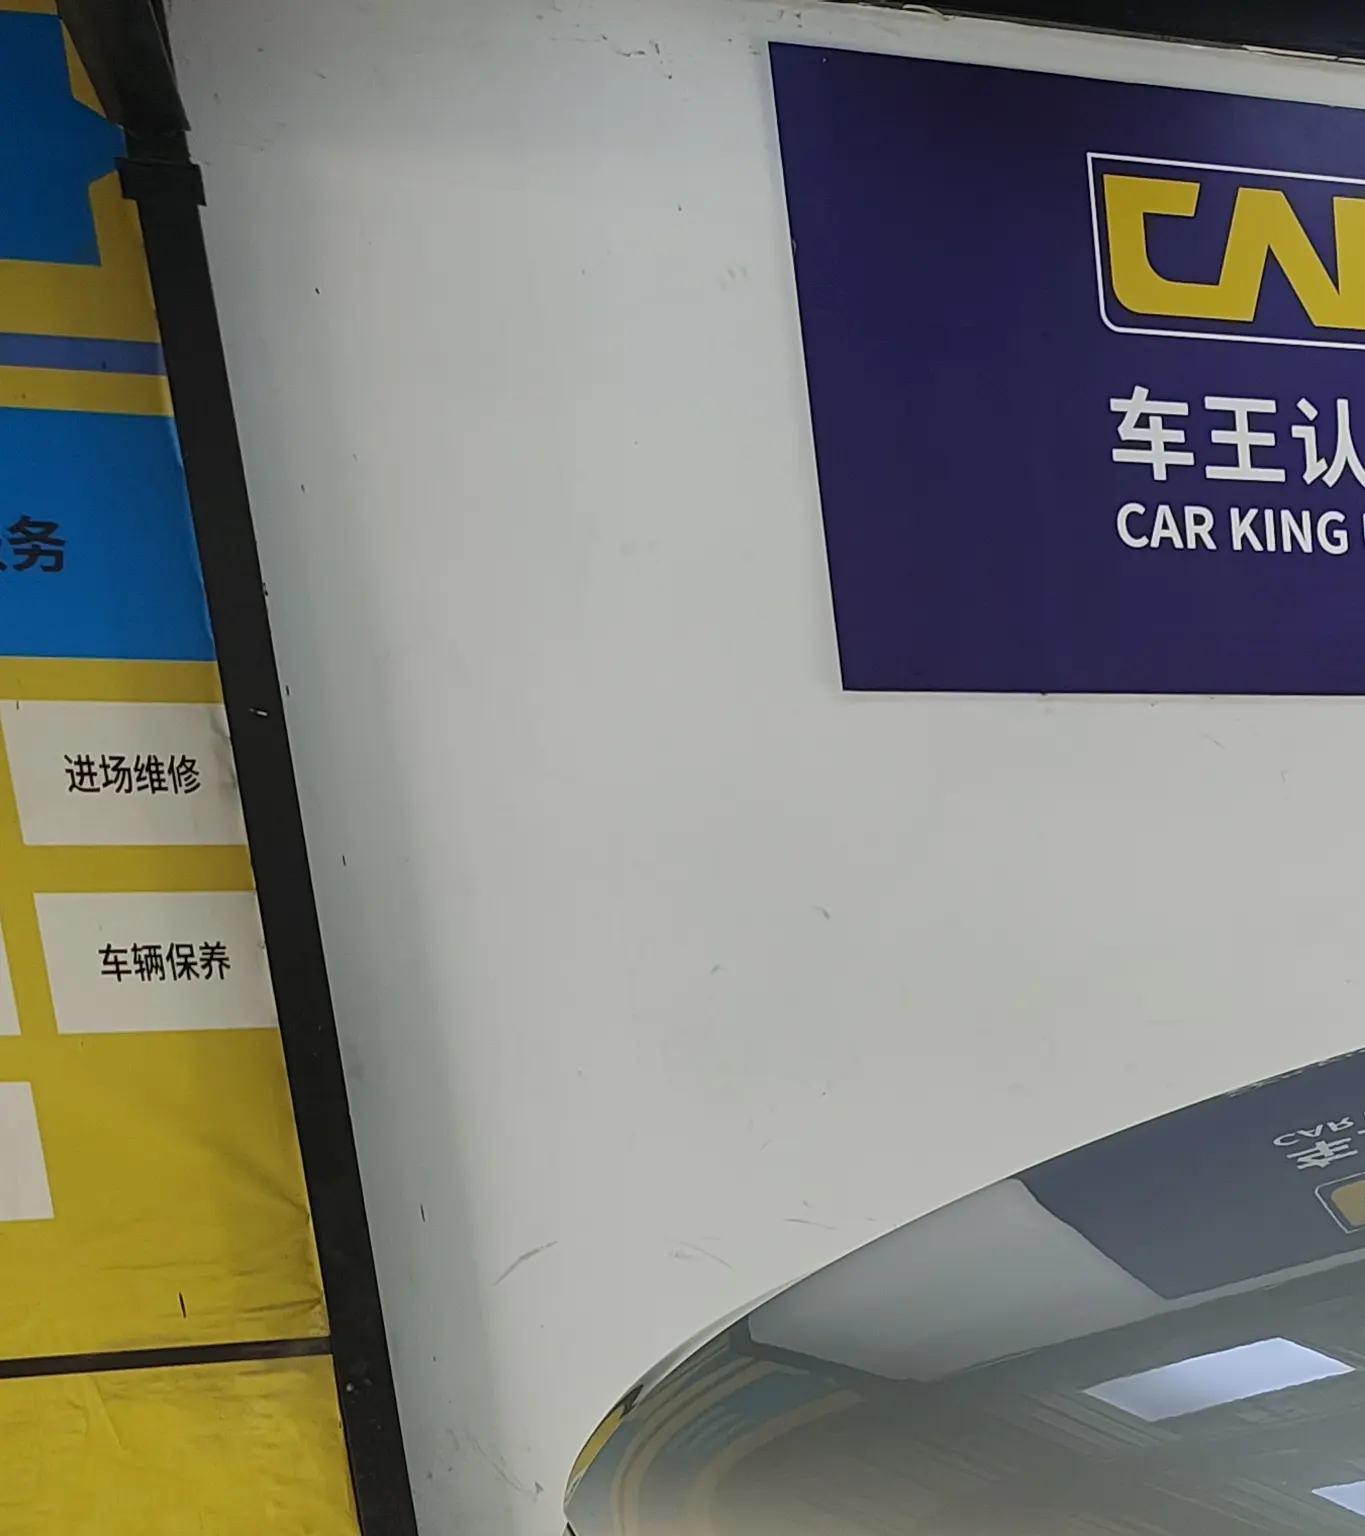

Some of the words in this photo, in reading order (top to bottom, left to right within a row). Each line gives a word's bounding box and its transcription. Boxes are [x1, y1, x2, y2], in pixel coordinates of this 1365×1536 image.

[0, 514, 66, 572] 务
[1116, 502, 1217, 550] CAR
[1230, 511, 1348, 556] KING
[64, 753, 202, 796] 进场维修
[98, 941, 231, 983] 车辆保养
